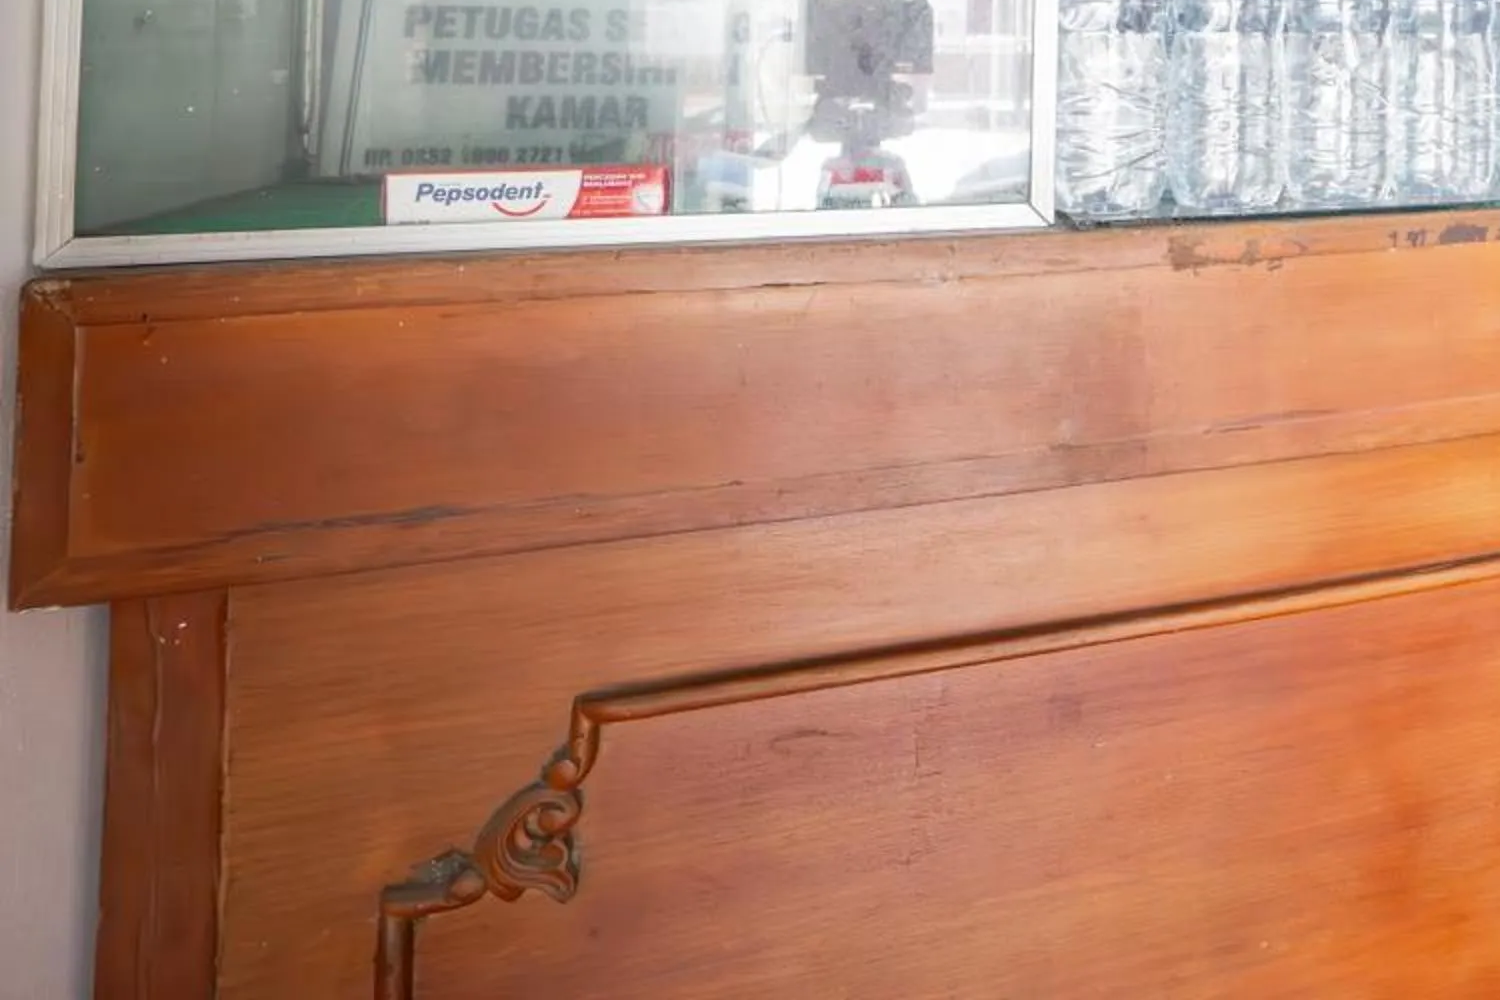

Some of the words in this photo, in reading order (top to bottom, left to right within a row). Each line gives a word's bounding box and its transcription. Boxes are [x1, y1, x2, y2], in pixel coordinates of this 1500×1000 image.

[404, 4, 592, 41] PETUGAS
[505, 95, 649, 131] KAMAR
[415, 181, 545, 206] Pepsodent
